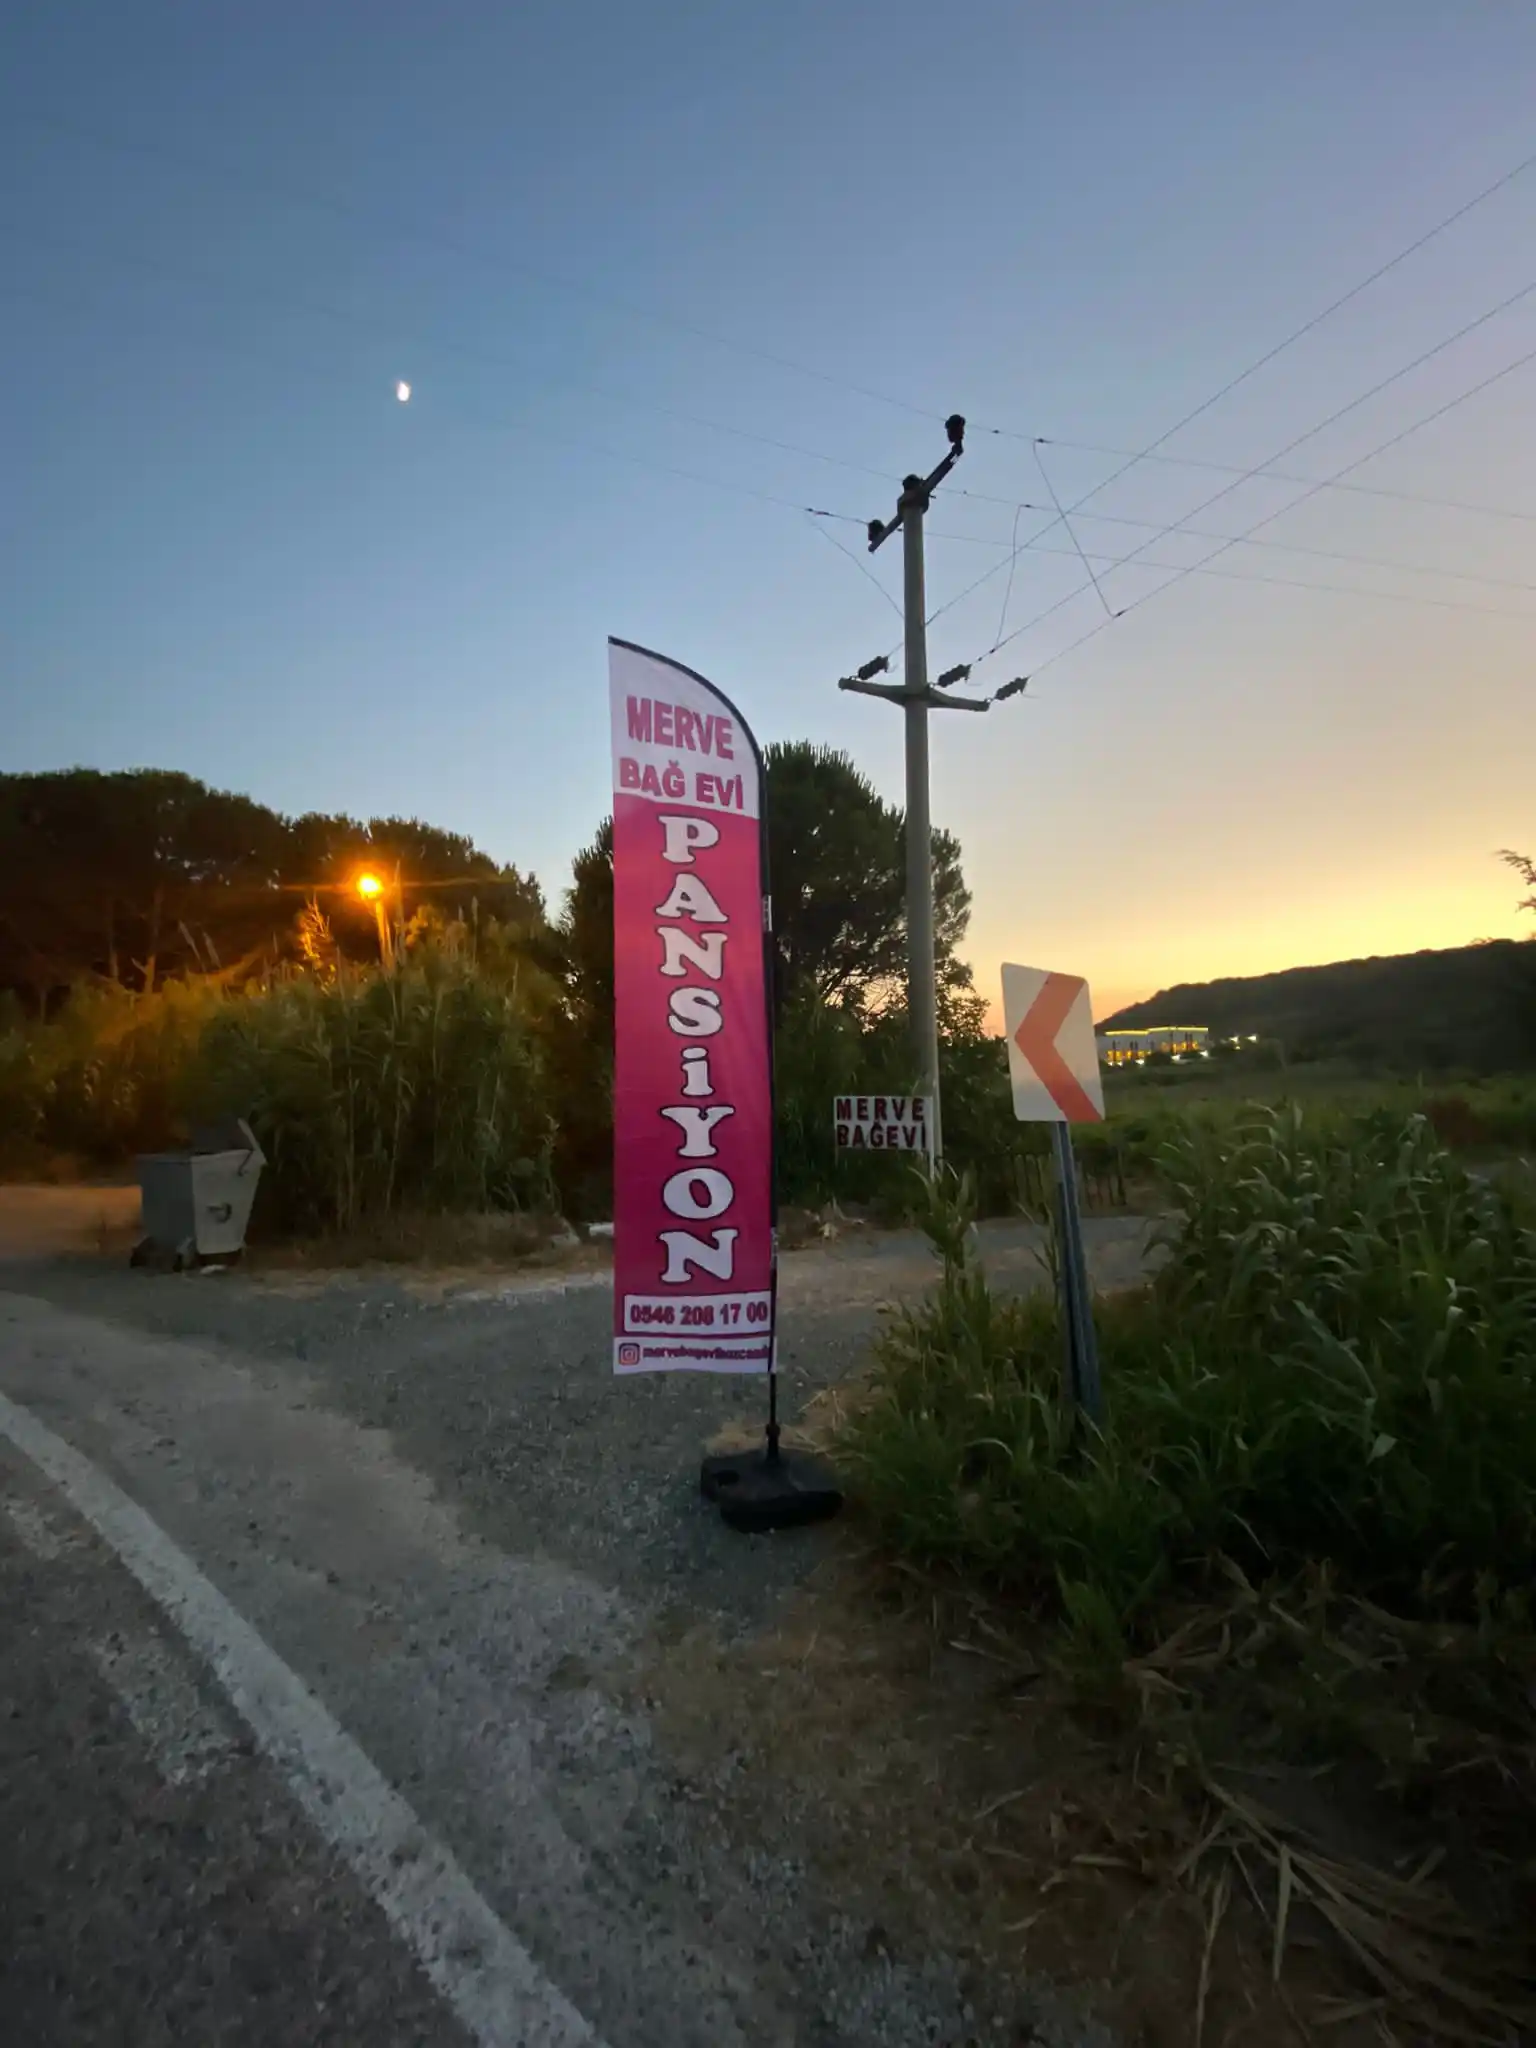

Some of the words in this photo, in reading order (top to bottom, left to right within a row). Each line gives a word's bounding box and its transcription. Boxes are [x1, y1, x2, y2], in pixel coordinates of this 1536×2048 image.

[626, 694, 733, 760] MERVE
[619, 757, 685, 798] BAĞ
[696, 772, 744, 810] EVİ
[836, 1098, 924, 1121] MERVE
[720, 1302, 741, 1325] 17
[746, 1301, 768, 1323] 00
